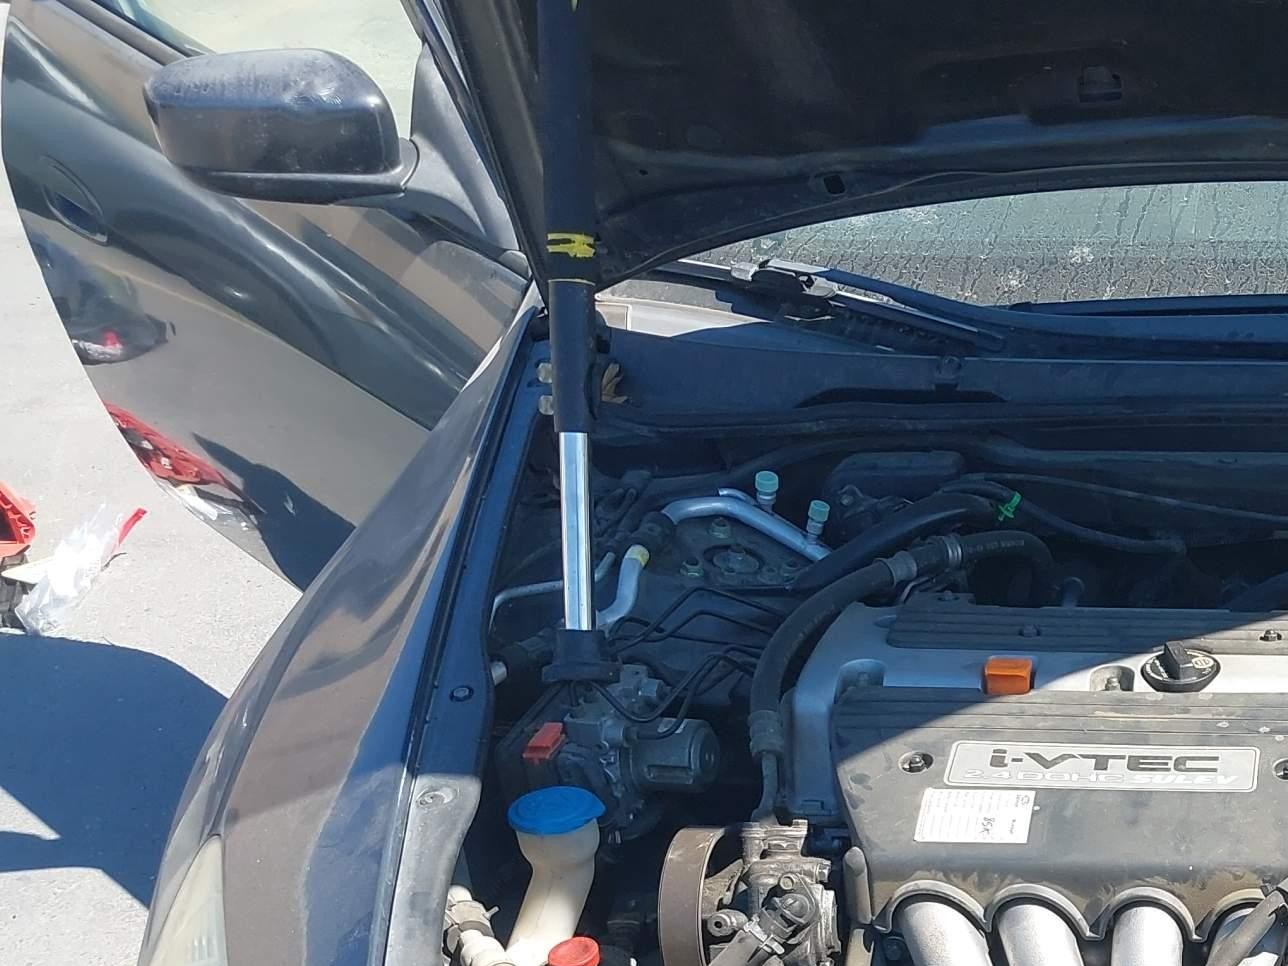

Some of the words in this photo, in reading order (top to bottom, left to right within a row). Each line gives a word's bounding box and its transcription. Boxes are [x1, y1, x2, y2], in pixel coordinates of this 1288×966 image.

[989, 748, 1220, 773] i-VTEC
[964, 769, 1012, 781] 2.4
[1015, 771, 1125, 784] DOHC
[1130, 775, 1238, 785] SULEV
